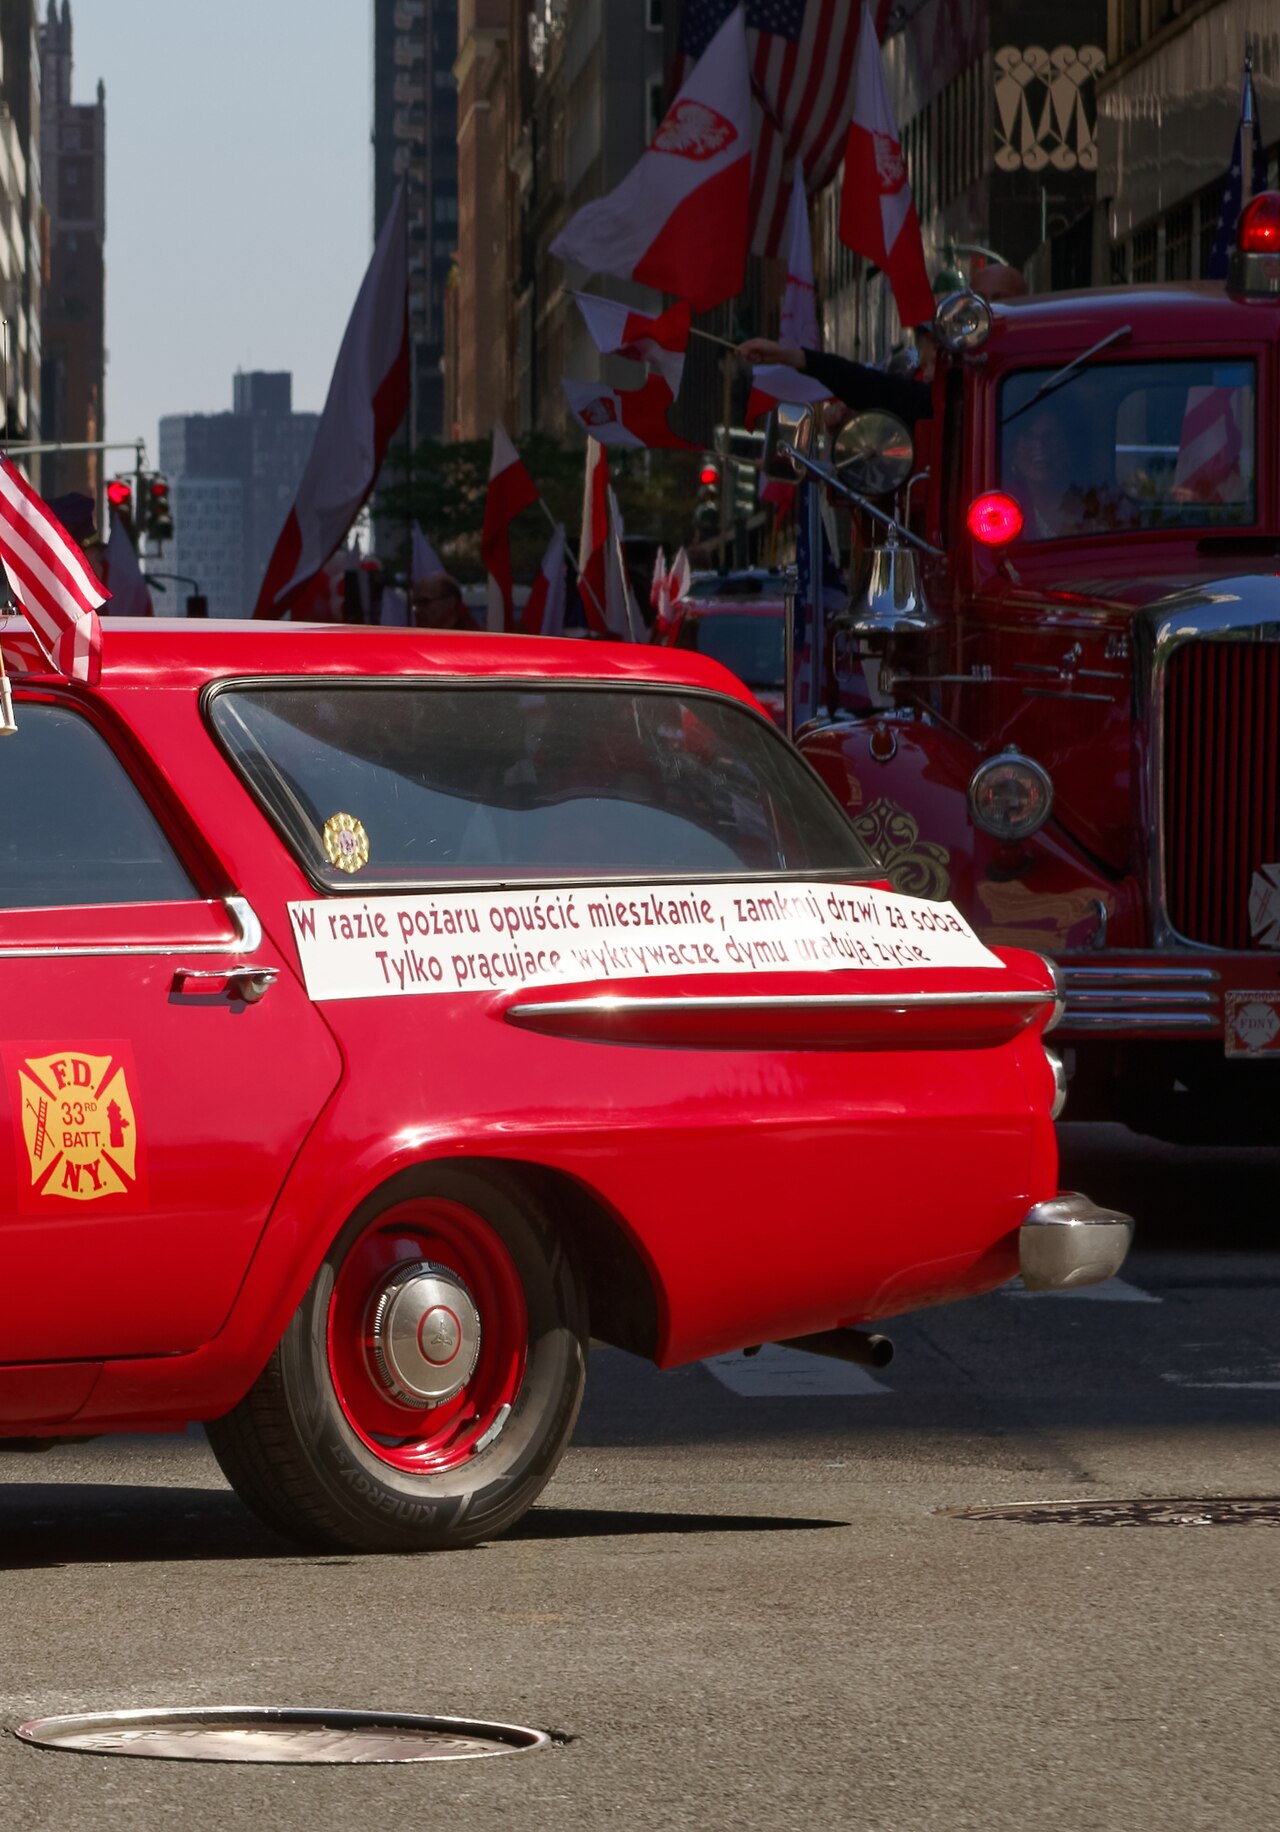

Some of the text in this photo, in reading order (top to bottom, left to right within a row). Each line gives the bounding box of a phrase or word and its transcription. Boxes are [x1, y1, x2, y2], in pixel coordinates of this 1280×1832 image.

[292, 907, 317, 942] W
[328, 904, 390, 940] razie
[397, 902, 482, 945] pożaru
[489, 894, 581, 940] opuścić
[827, 891, 881, 926] drzwi
[886, 905, 908, 930] za
[911, 906, 972, 938] sobą
[375, 949, 444, 991] Tylko
[571, 940, 720, 976] wykrywacze
[724, 935, 790, 970] dymu
[871, 936, 932, 966] życie
[1240, 1018, 1274, 1030] FDNY
[49, 1059, 95, 1090] F.D.
[62, 1131, 106, 1148] BATT.
[61, 1159, 107, 1193] N.Y.
